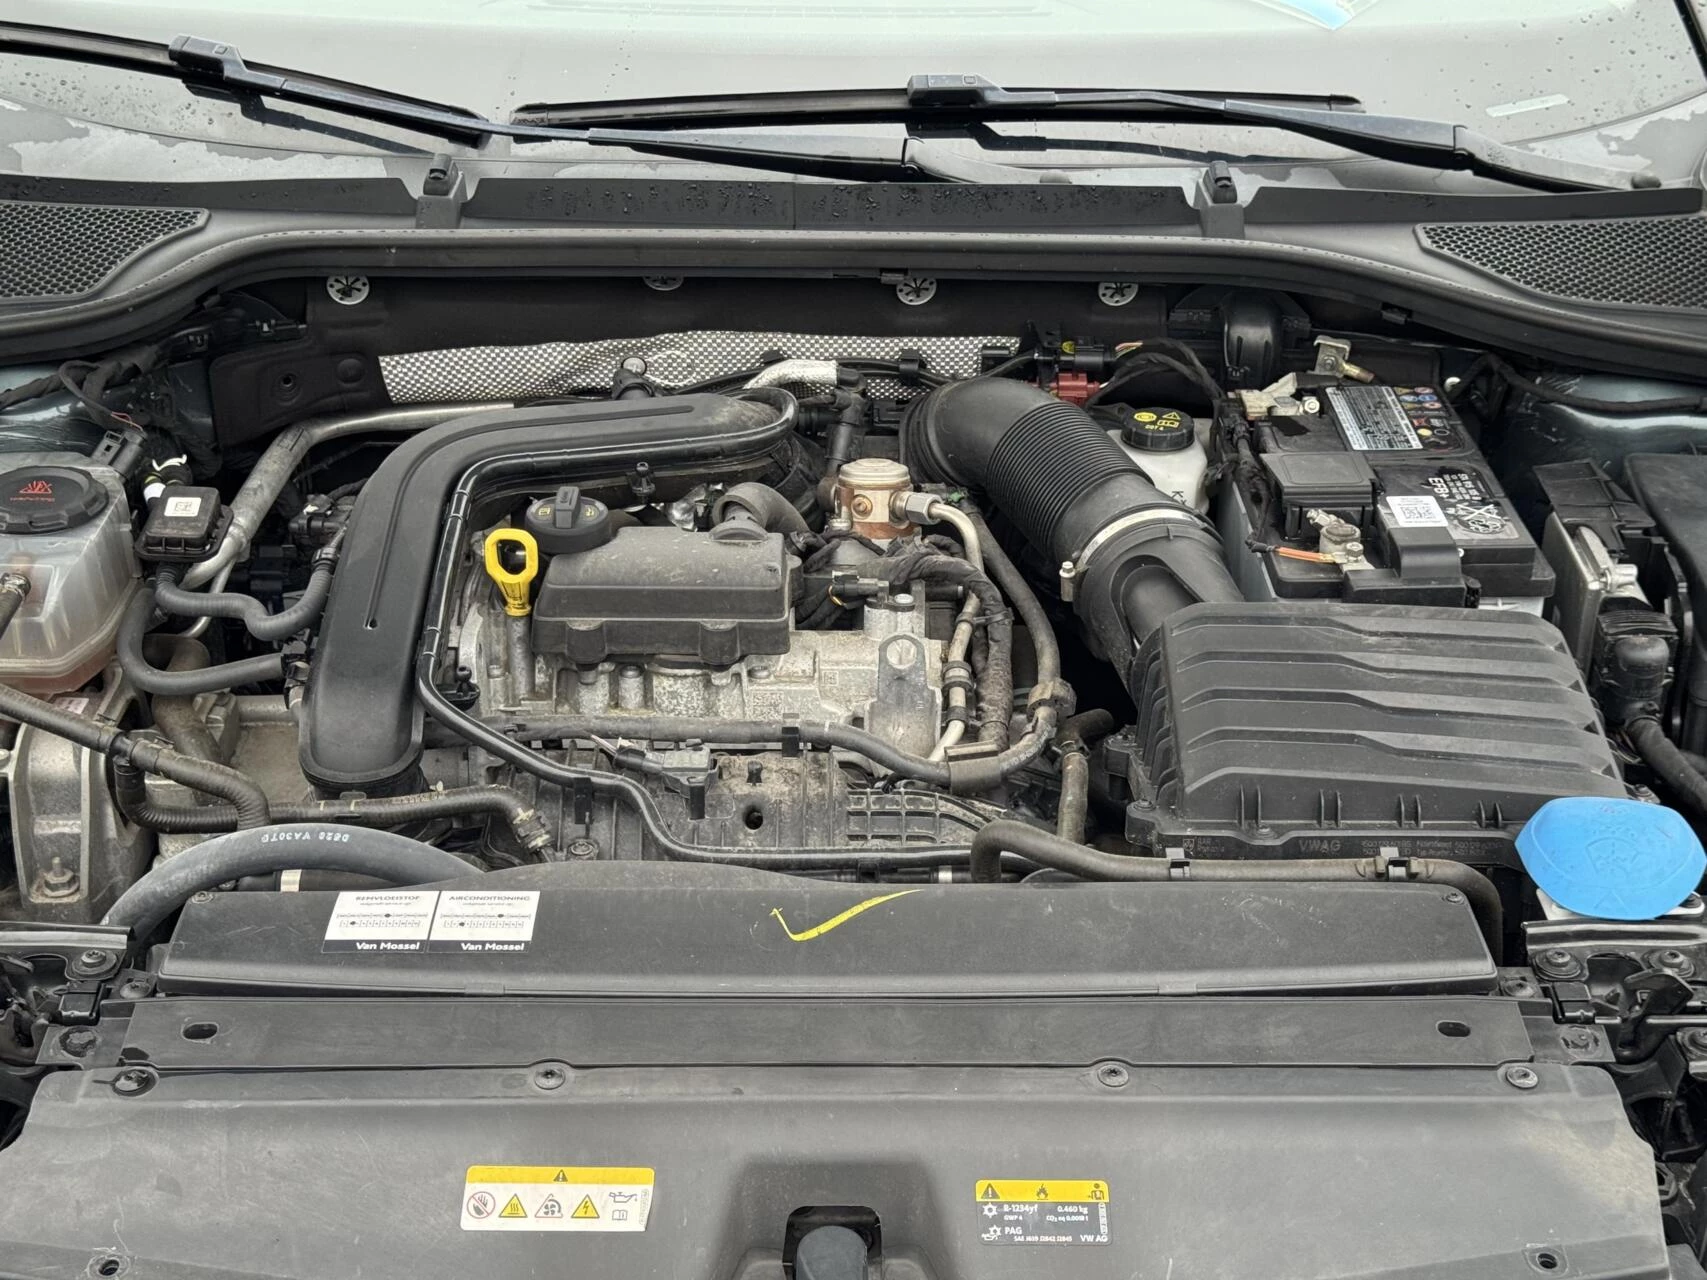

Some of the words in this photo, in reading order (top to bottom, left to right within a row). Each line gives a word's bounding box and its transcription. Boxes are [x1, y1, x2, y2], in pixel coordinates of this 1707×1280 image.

[356, 942, 378, 950] Van
[380, 942, 421, 950] Mossel
[460, 942, 483, 951] Van
[484, 942, 525, 951] Mossel
[1004, 1204, 1038, 1214] R-1234yf
[1079, 1205, 1089, 1214] kg
[1004, 1226, 1022, 1234] PAG
[1080, 1234, 1095, 1242] VW
[1095, 1234, 1109, 1242] AG
